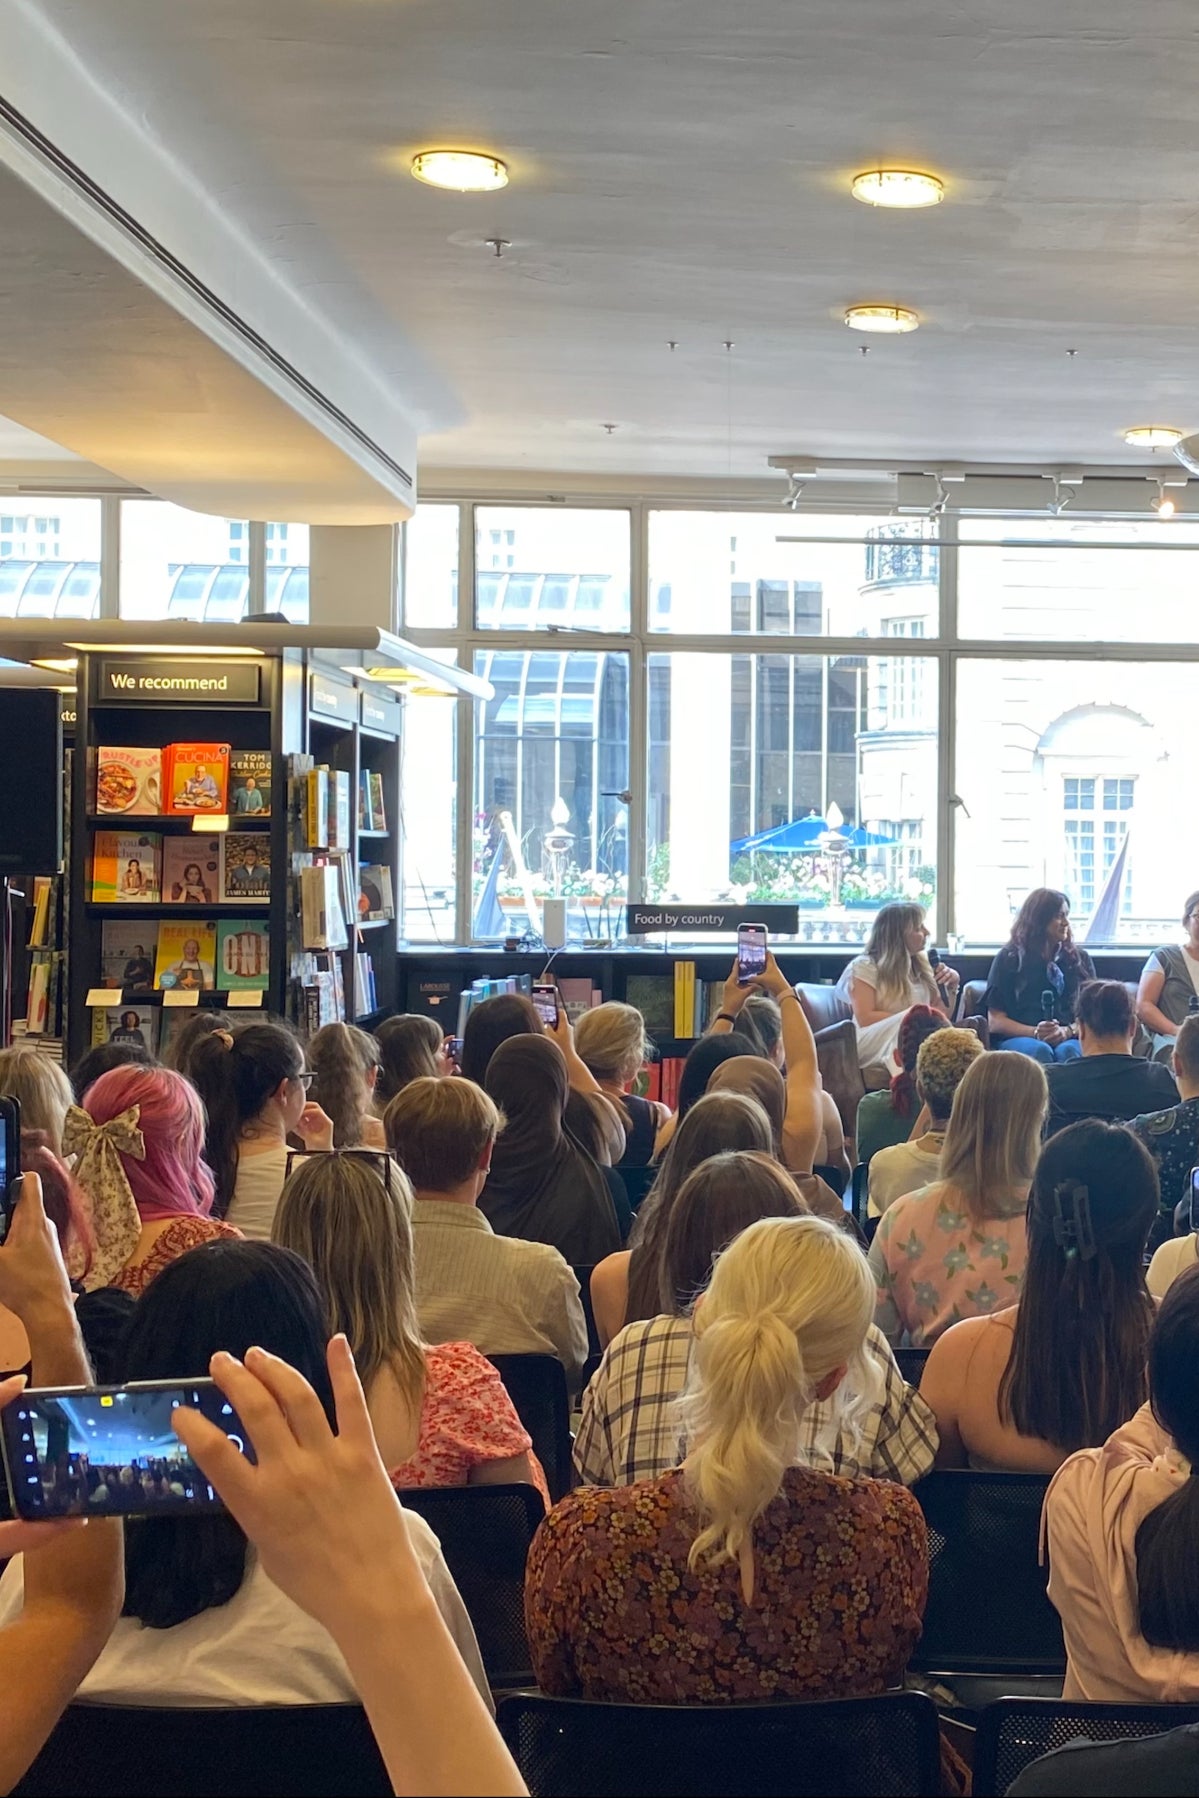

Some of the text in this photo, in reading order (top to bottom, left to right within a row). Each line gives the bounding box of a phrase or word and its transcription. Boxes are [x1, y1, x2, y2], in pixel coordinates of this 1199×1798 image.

[111, 674, 227, 690] We recommend
[102, 751, 158, 768] RUSTLE UP
[175, 752, 223, 763] CUCINA
[243, 753, 265, 762] TOM
[635, 913, 725, 928] Food by country
